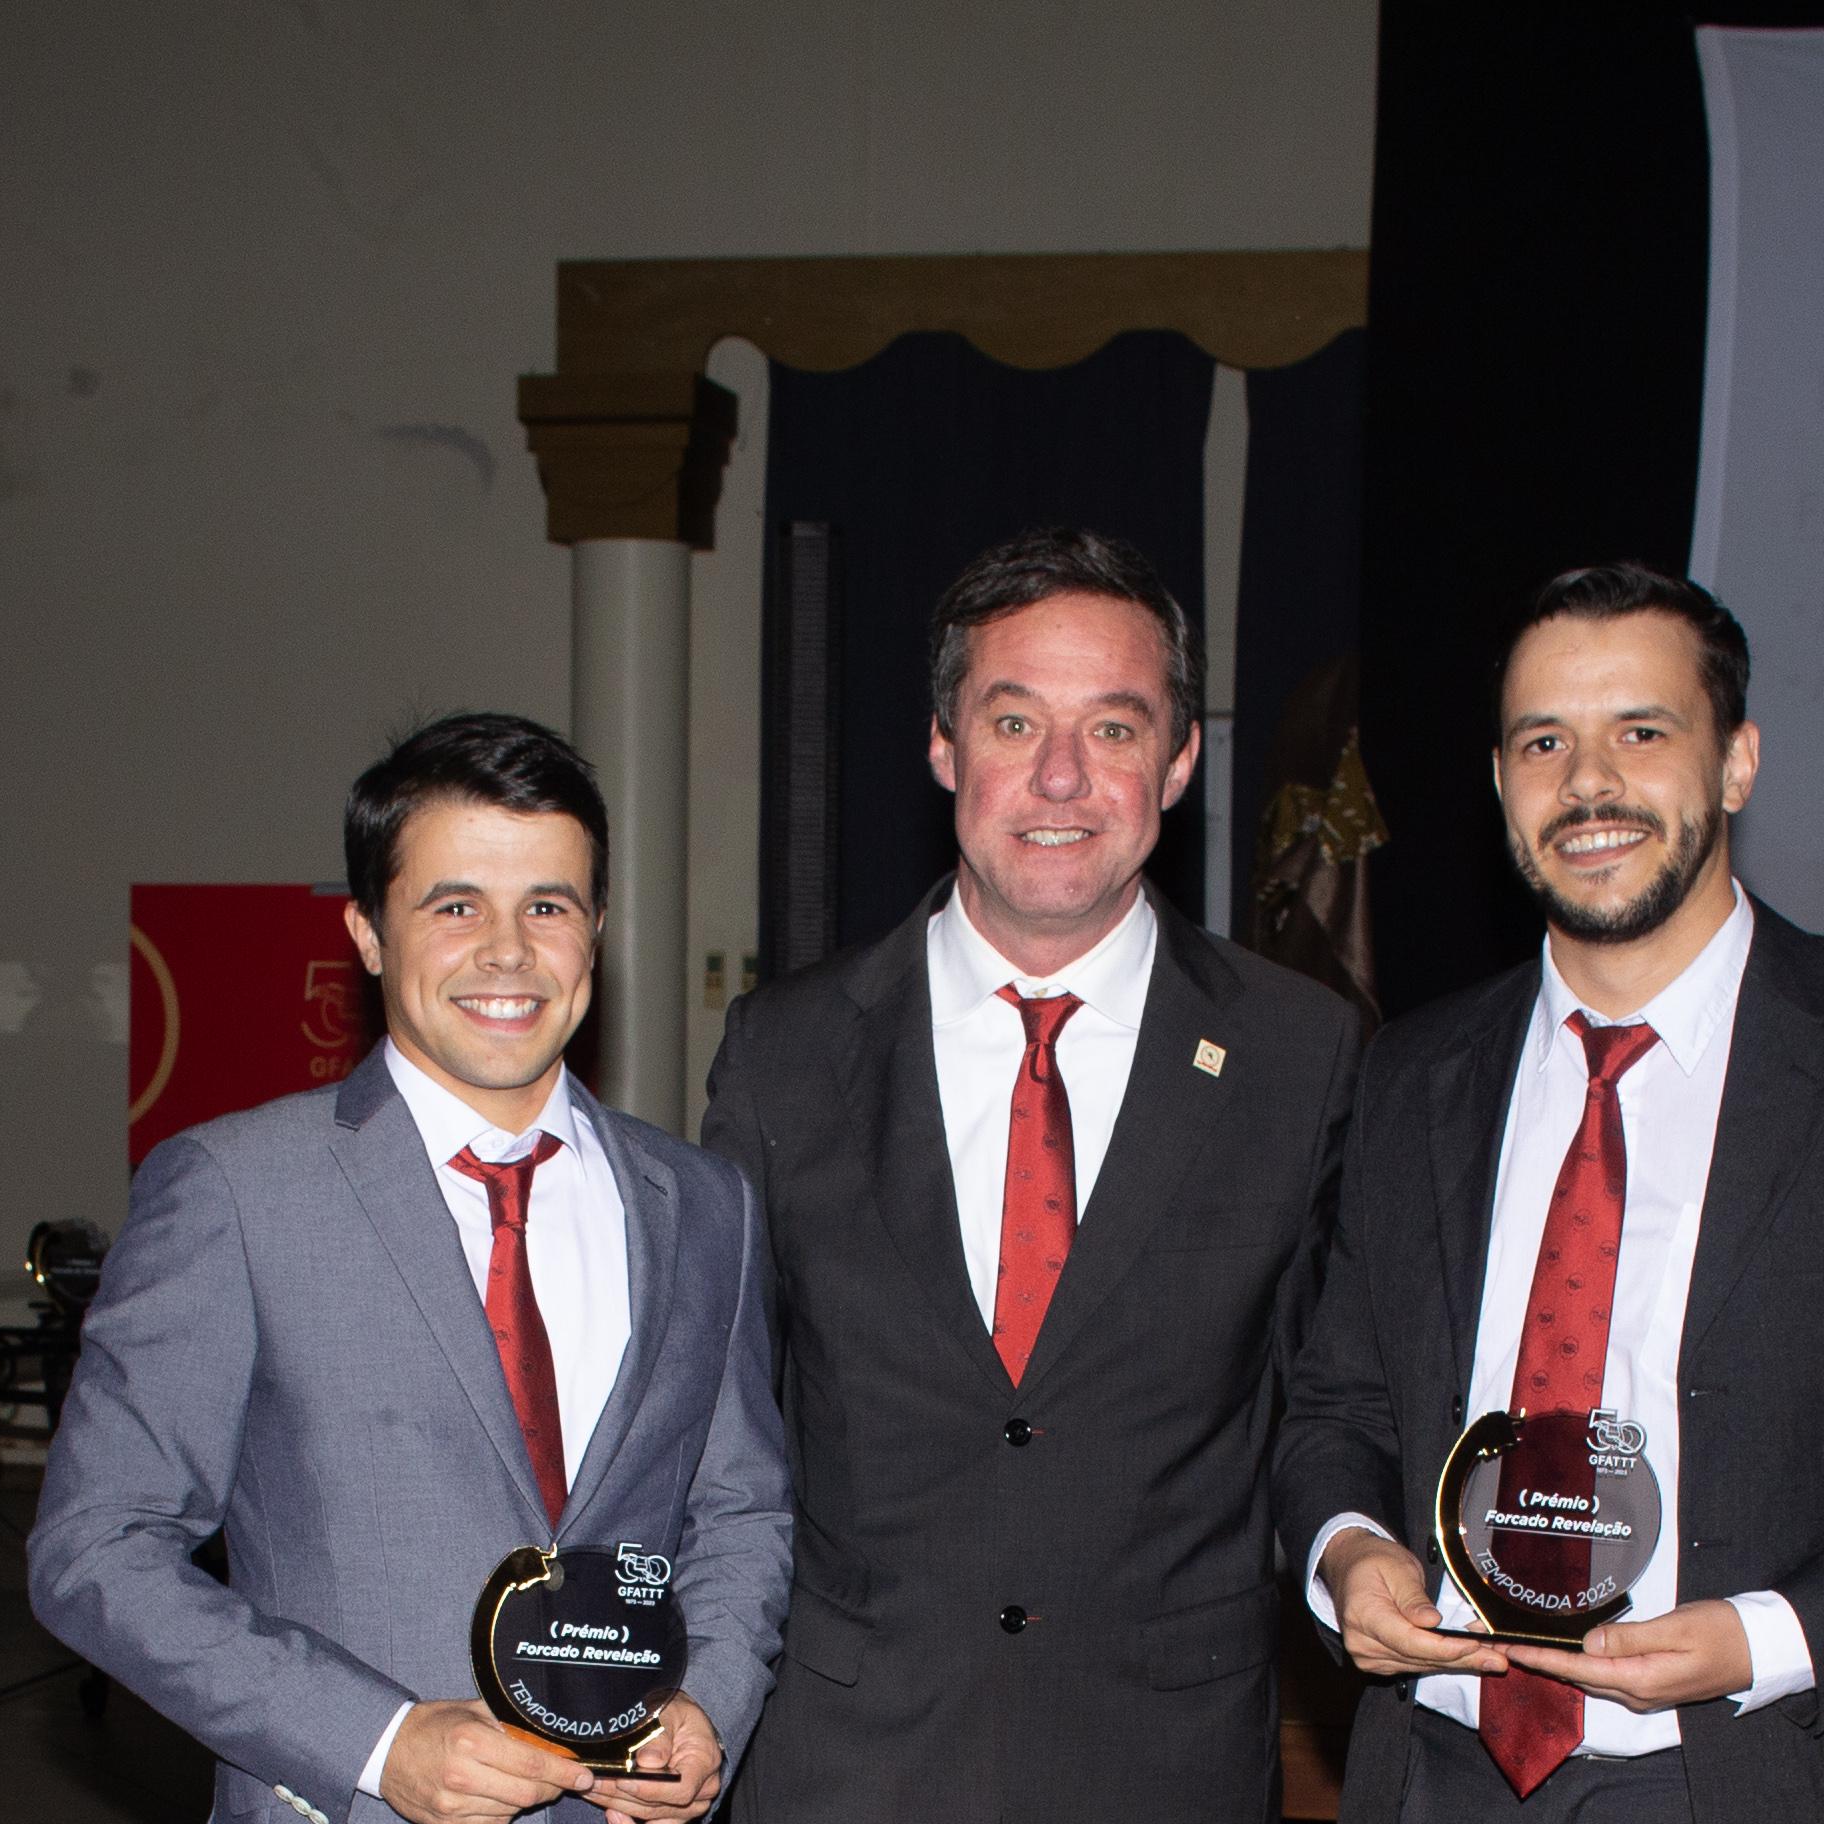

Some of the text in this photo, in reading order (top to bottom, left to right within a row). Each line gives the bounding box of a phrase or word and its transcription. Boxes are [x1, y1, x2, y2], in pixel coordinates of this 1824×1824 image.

[1588, 1453, 1638, 1469] GFATTT
[1484, 1509, 1632, 1537] Forcado Revelação
[1476, 1547, 1616, 1610] TEMPORADA 2023
[617, 1585, 665, 1600] GFATTT
[516, 1641, 661, 1665] Forcado Revelação
[509, 1679, 647, 1737] TEMPORADA 2023
